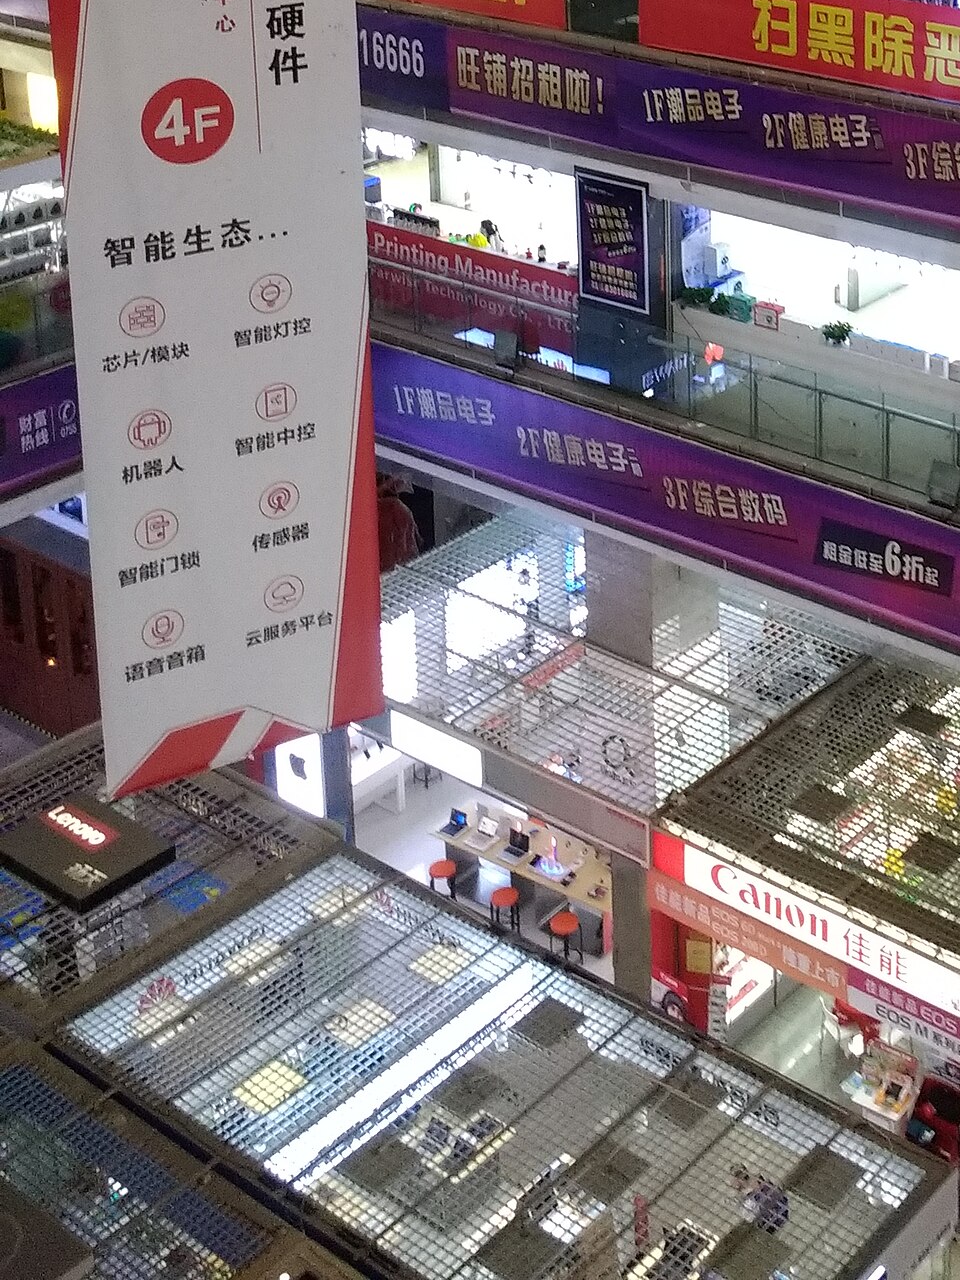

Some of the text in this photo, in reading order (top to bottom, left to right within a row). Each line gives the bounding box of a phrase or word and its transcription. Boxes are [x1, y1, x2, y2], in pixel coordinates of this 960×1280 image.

[642, 86, 744, 124] 1F潮品电子
[152, 100, 222, 147] 4F
[373, 231, 450, 275] Printing
[233, 317, 312, 349] 智能灯控
[102, 341, 190, 374] 芯片/模块
[18, 408, 48, 433] 财富
[21, 427, 50, 454] 热线
[234, 422, 316, 457] 智能中控
[121, 455, 185, 485] 机器人
[394, 384, 497, 428] 1F潮品电子
[662, 476, 788, 527] 3F综合数码
[822, 540, 940, 588] 租金低至6折起
[252, 522, 311, 553] 传感器
[118, 550, 201, 589] 智能门锁
[245, 610, 334, 648] 云服务平台
[125, 644, 206, 684] 语音音箱
[711, 864, 908, 984] Canon 佳能
[875, 1002, 912, 1031] EOS
[920, 1004, 958, 1037] EOS
